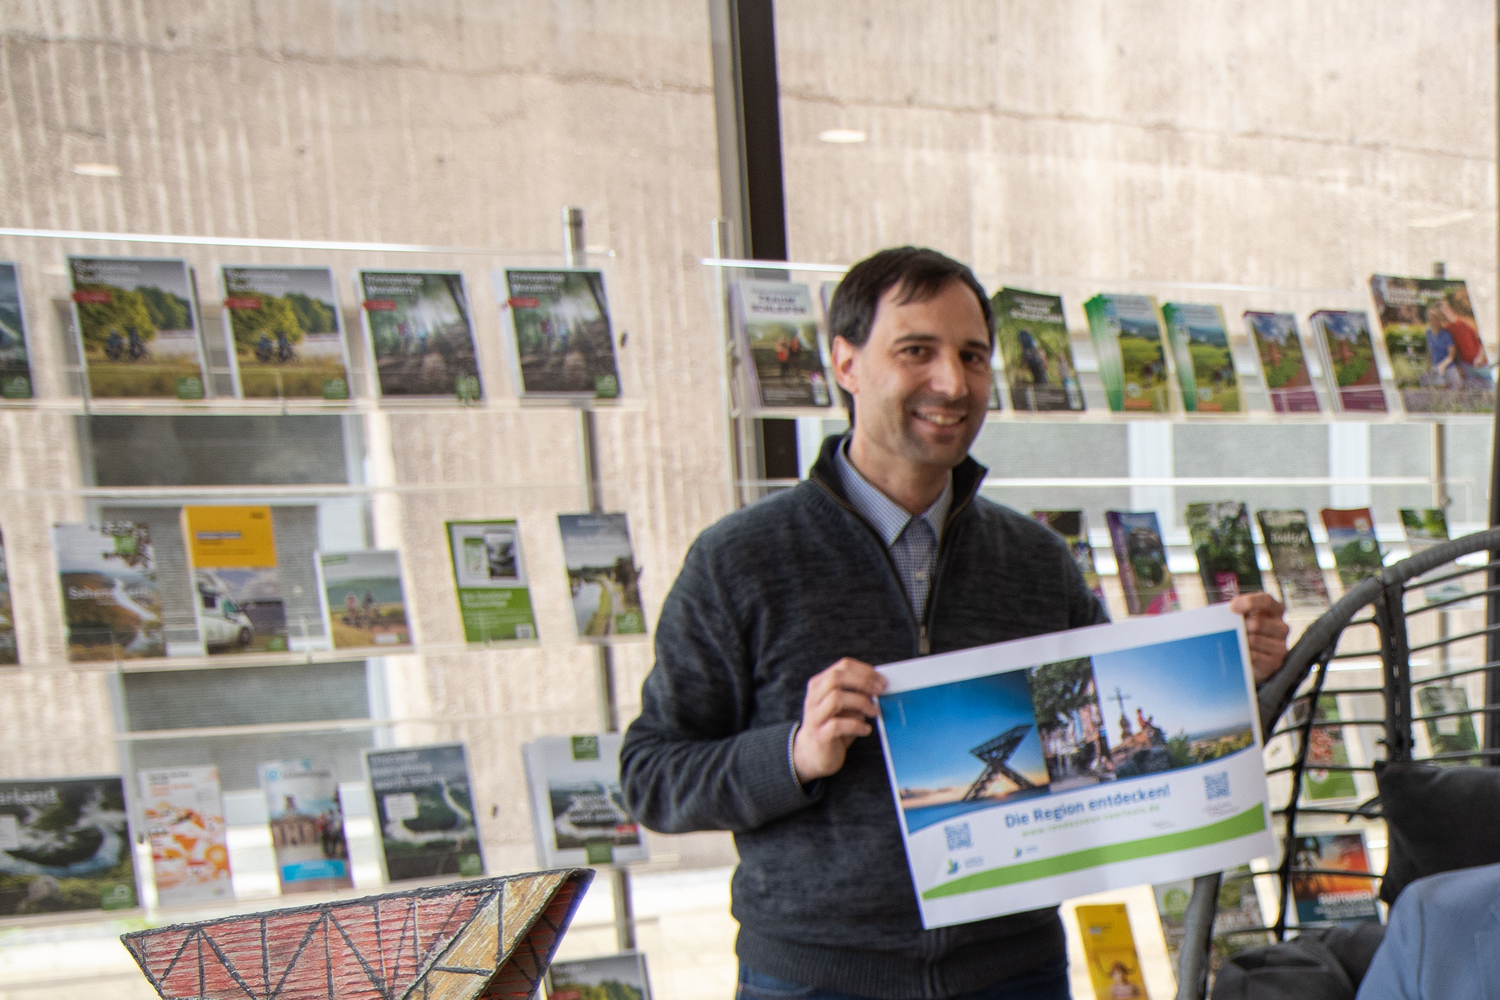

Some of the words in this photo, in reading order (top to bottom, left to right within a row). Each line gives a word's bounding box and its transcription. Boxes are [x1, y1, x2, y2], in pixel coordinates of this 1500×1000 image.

[1004, 812, 1029, 828] Die
[1033, 802, 1085, 822] Region
[1088, 783, 1171, 811] entdecken!
